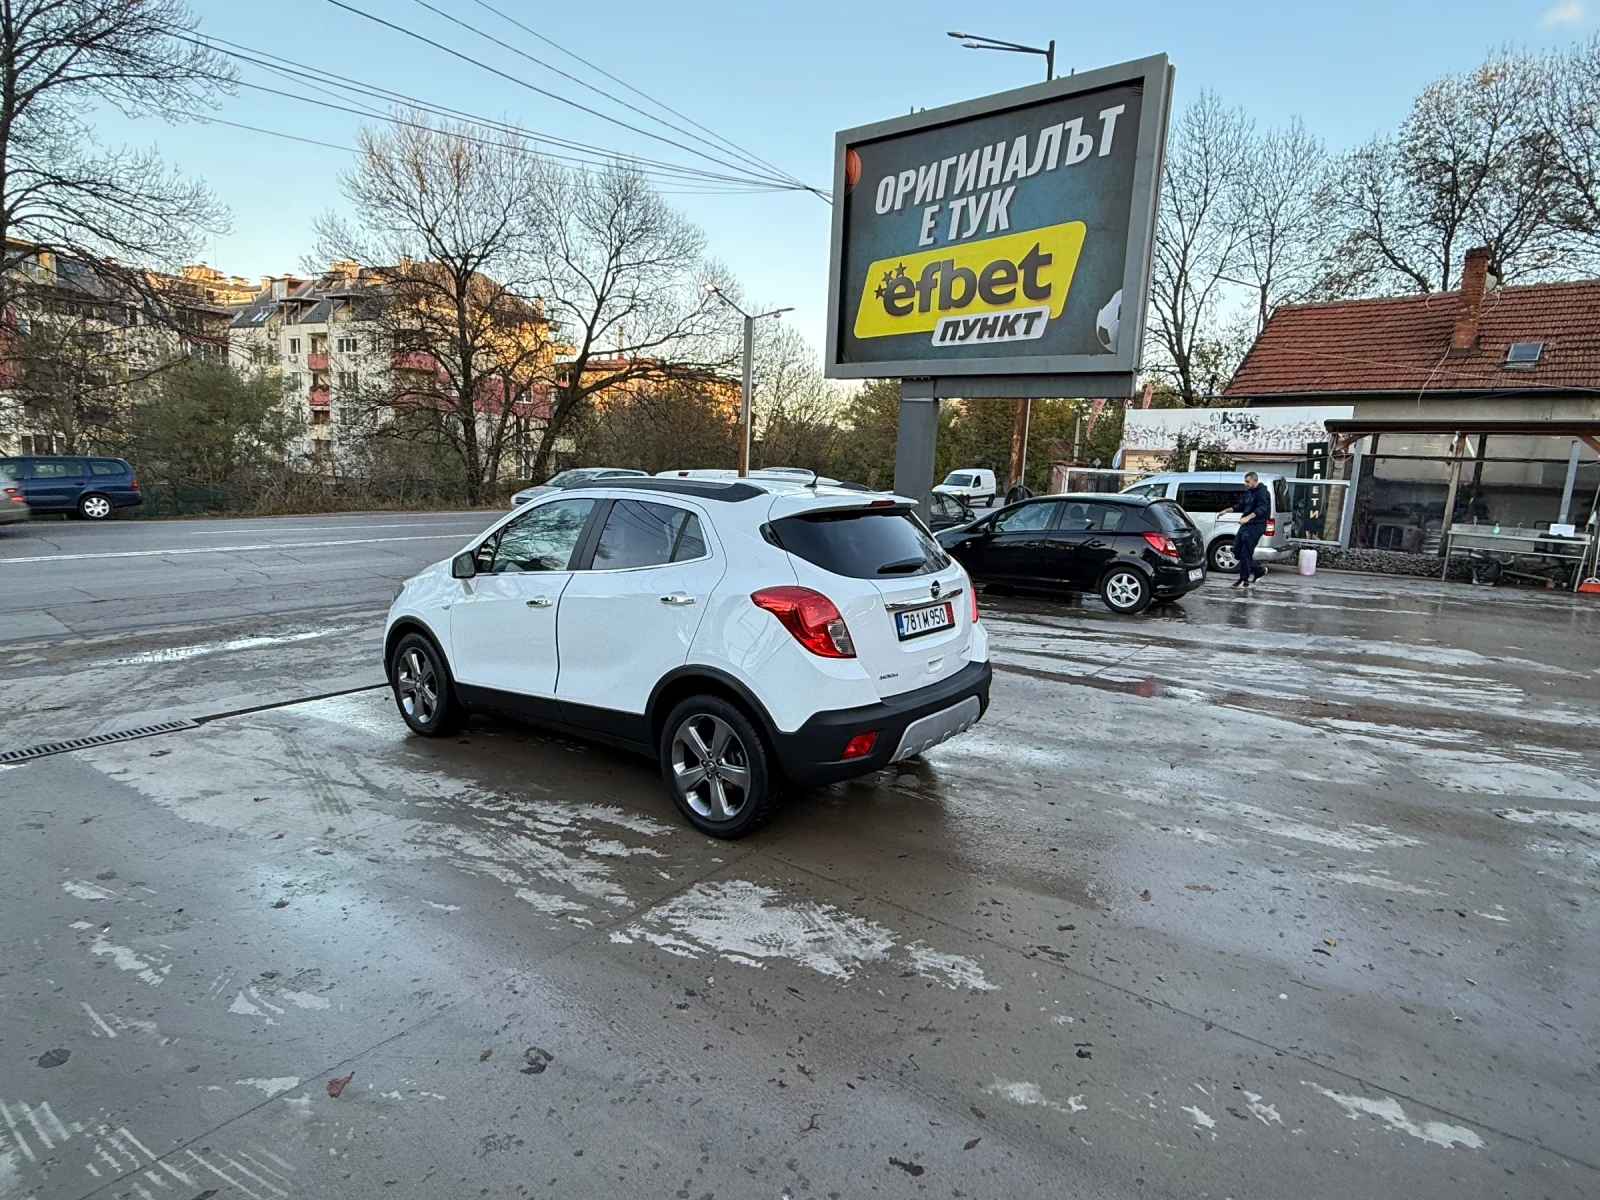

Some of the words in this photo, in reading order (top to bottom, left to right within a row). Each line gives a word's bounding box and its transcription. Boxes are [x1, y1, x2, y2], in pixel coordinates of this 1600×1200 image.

[875, 104, 1126, 215] ОРИГИНАЛЪТ
[918, 204, 937, 246] Е
[948, 185, 1017, 241] ТУК
[883, 242, 1053, 317] efbet
[938, 311, 1043, 342] ПУНКТ
[1255, 438, 1327, 450] ПЕЛЕ
[1310, 448, 1322, 519] ПЕЛЕТИ
